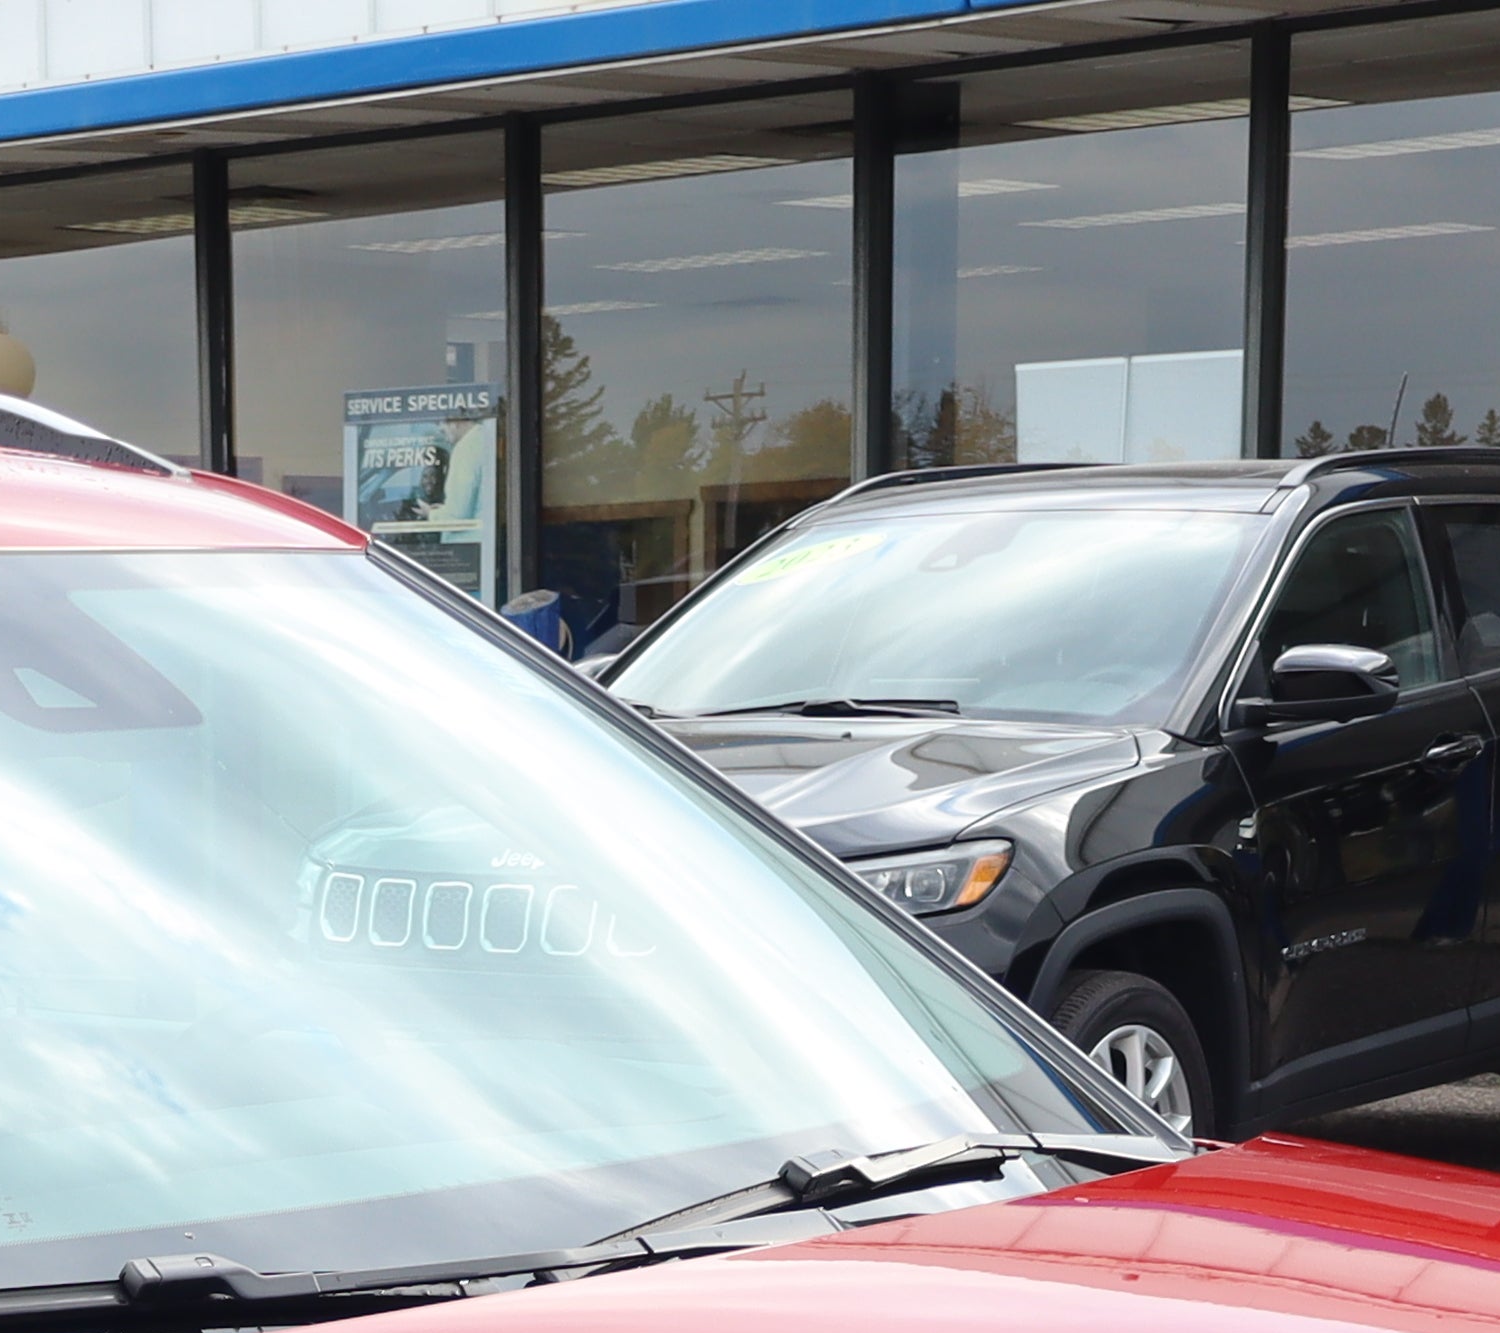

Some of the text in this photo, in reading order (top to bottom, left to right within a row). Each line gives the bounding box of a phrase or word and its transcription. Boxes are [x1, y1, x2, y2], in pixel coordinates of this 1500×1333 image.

[346, 391, 490, 416] SERVICE SPECIALS
[361, 446, 441, 468] ITS PERKS.
